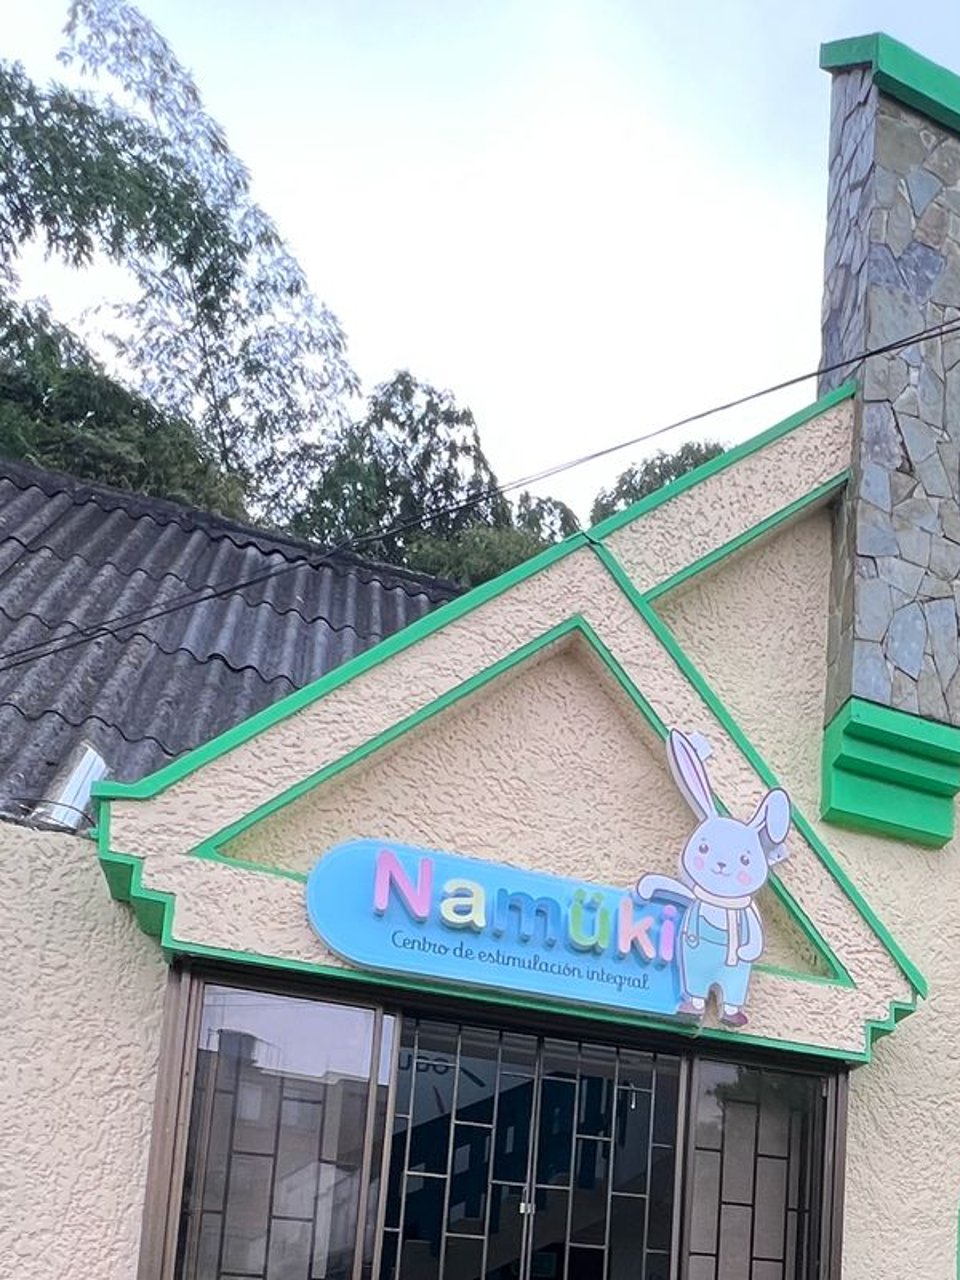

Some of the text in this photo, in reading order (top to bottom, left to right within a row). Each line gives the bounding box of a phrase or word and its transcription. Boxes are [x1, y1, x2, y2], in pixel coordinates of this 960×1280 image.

[373, 850, 677, 966] Namüki
[391, 931, 650, 991] Centro de estimulación integral
